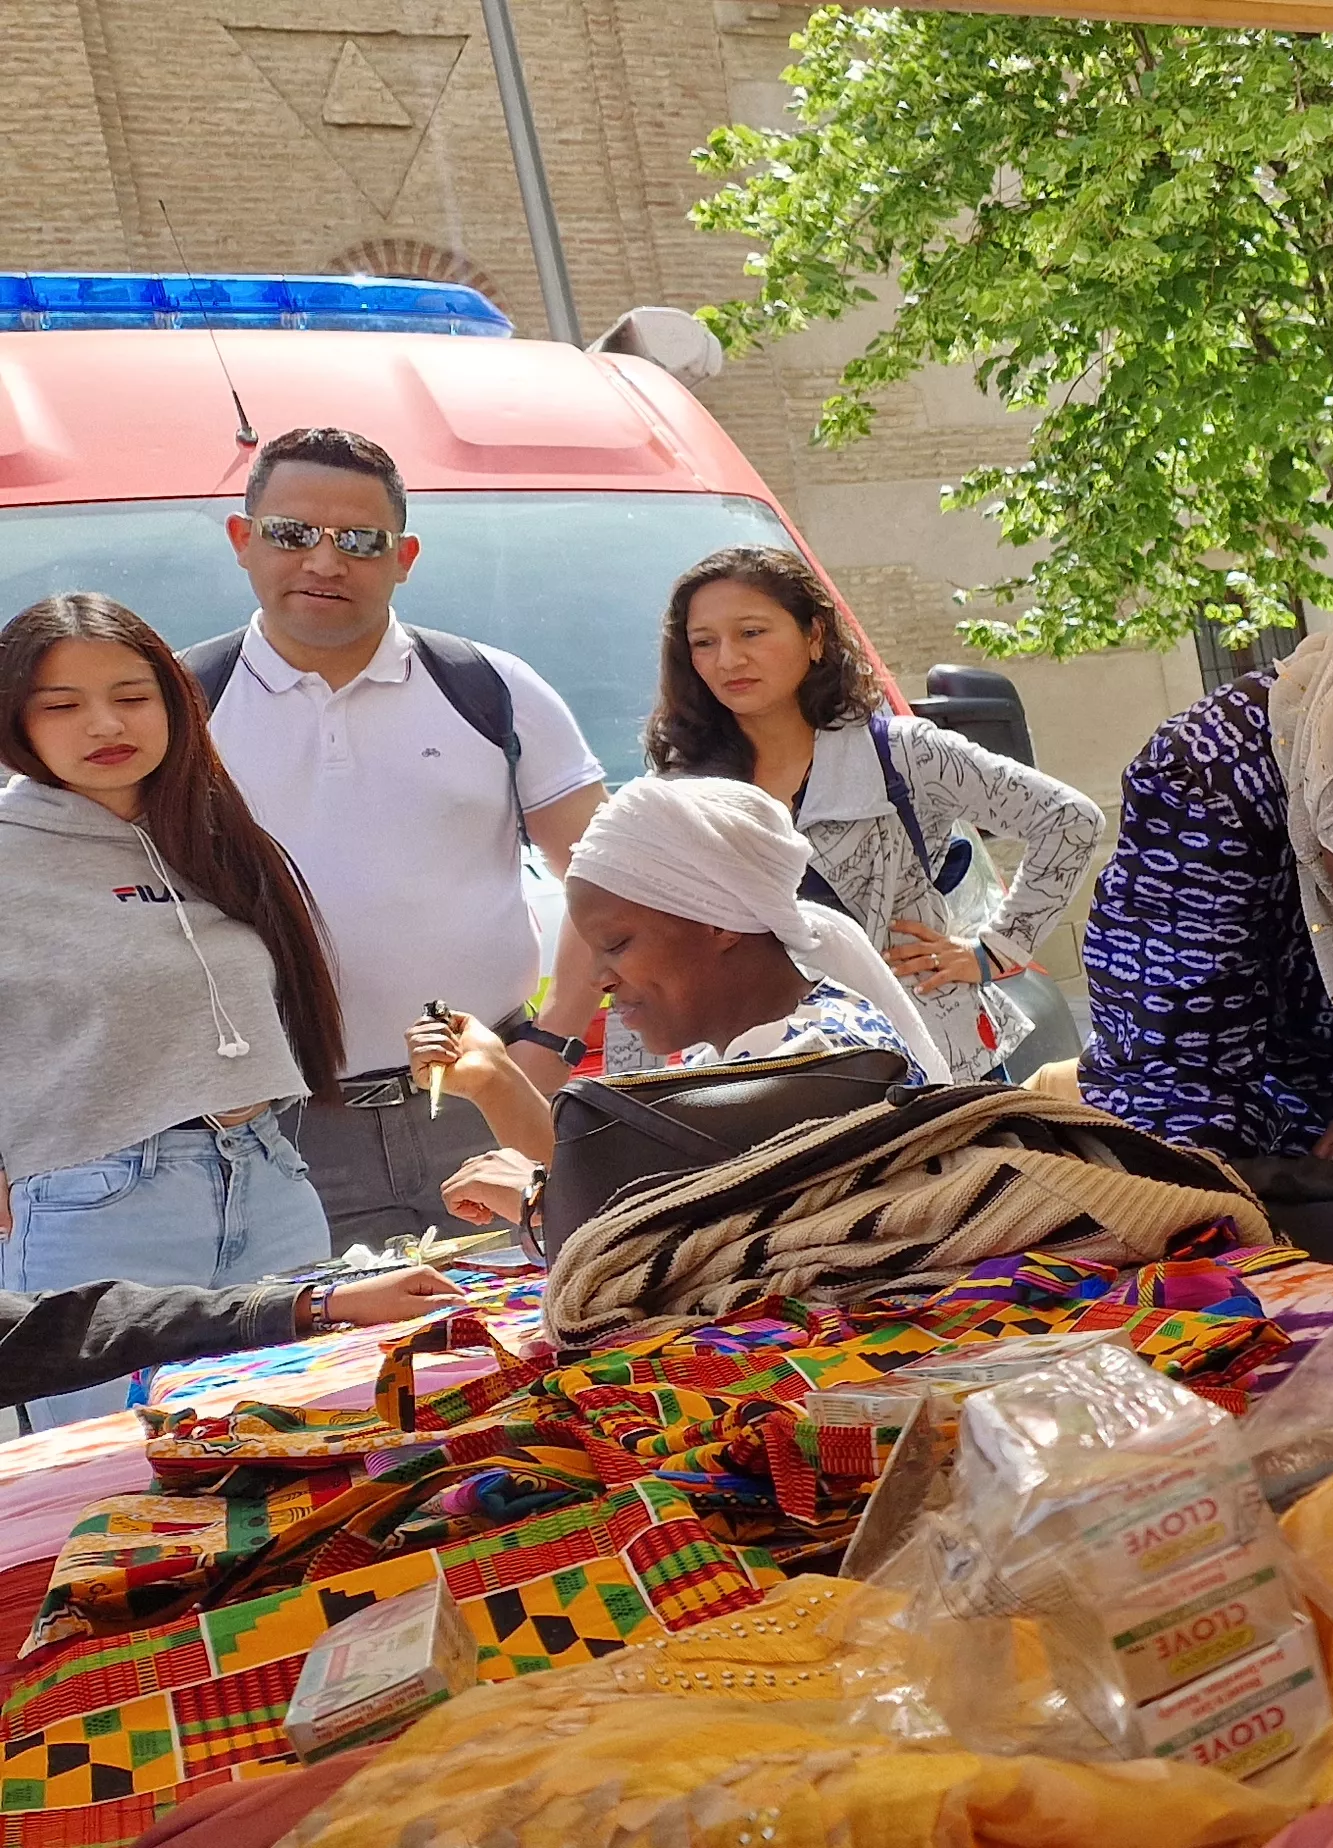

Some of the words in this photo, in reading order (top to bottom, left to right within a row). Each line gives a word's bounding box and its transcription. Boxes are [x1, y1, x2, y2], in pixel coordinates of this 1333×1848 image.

[1122, 1498, 1219, 1556] CLOVE
[1152, 1602, 1248, 1660] CLOVE
[1192, 1706, 1285, 1765] CLOVE
